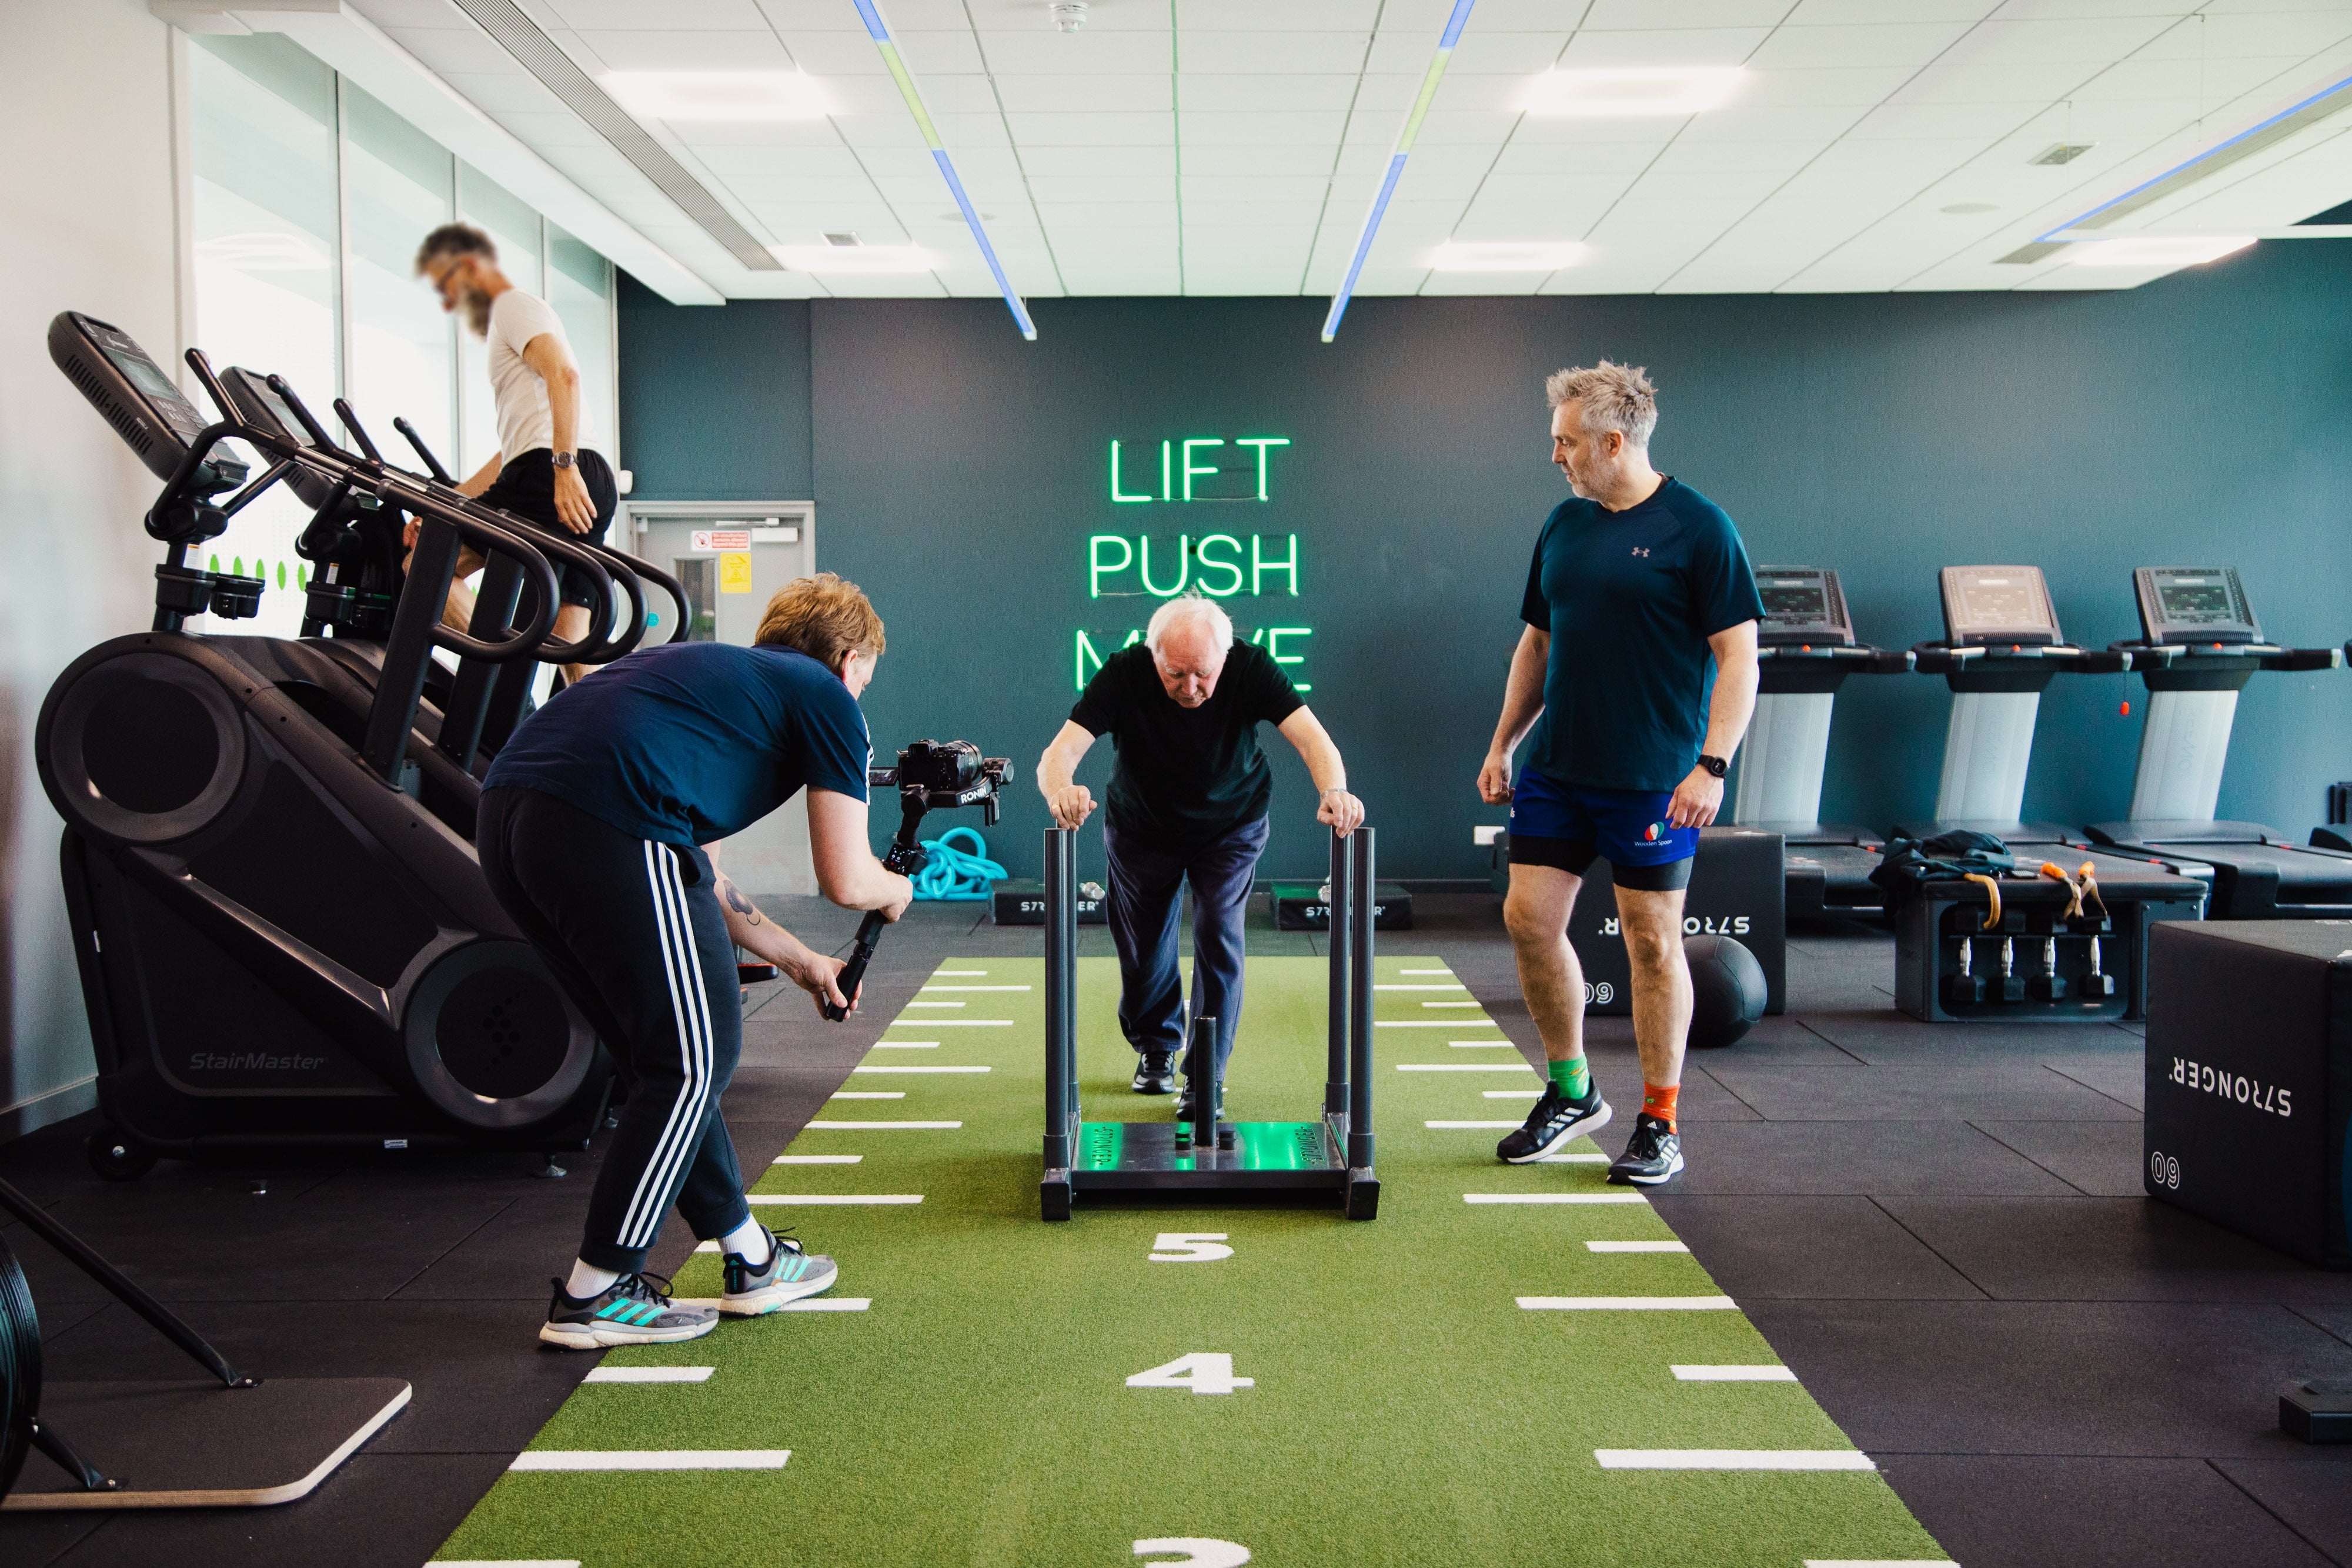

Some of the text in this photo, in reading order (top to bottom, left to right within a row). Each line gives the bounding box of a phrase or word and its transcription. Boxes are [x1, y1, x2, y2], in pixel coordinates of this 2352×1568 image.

[1111, 438, 1291, 503] LIFT
[1090, 533, 1298, 599] PUSH
[1075, 627, 1313, 692] ME
[960, 785, 987, 804] RONIN
[189, 1052, 325, 1070] StairMaster
[1148, 1232, 1235, 1262] 5
[1125, 1352, 1255, 1394] 4
